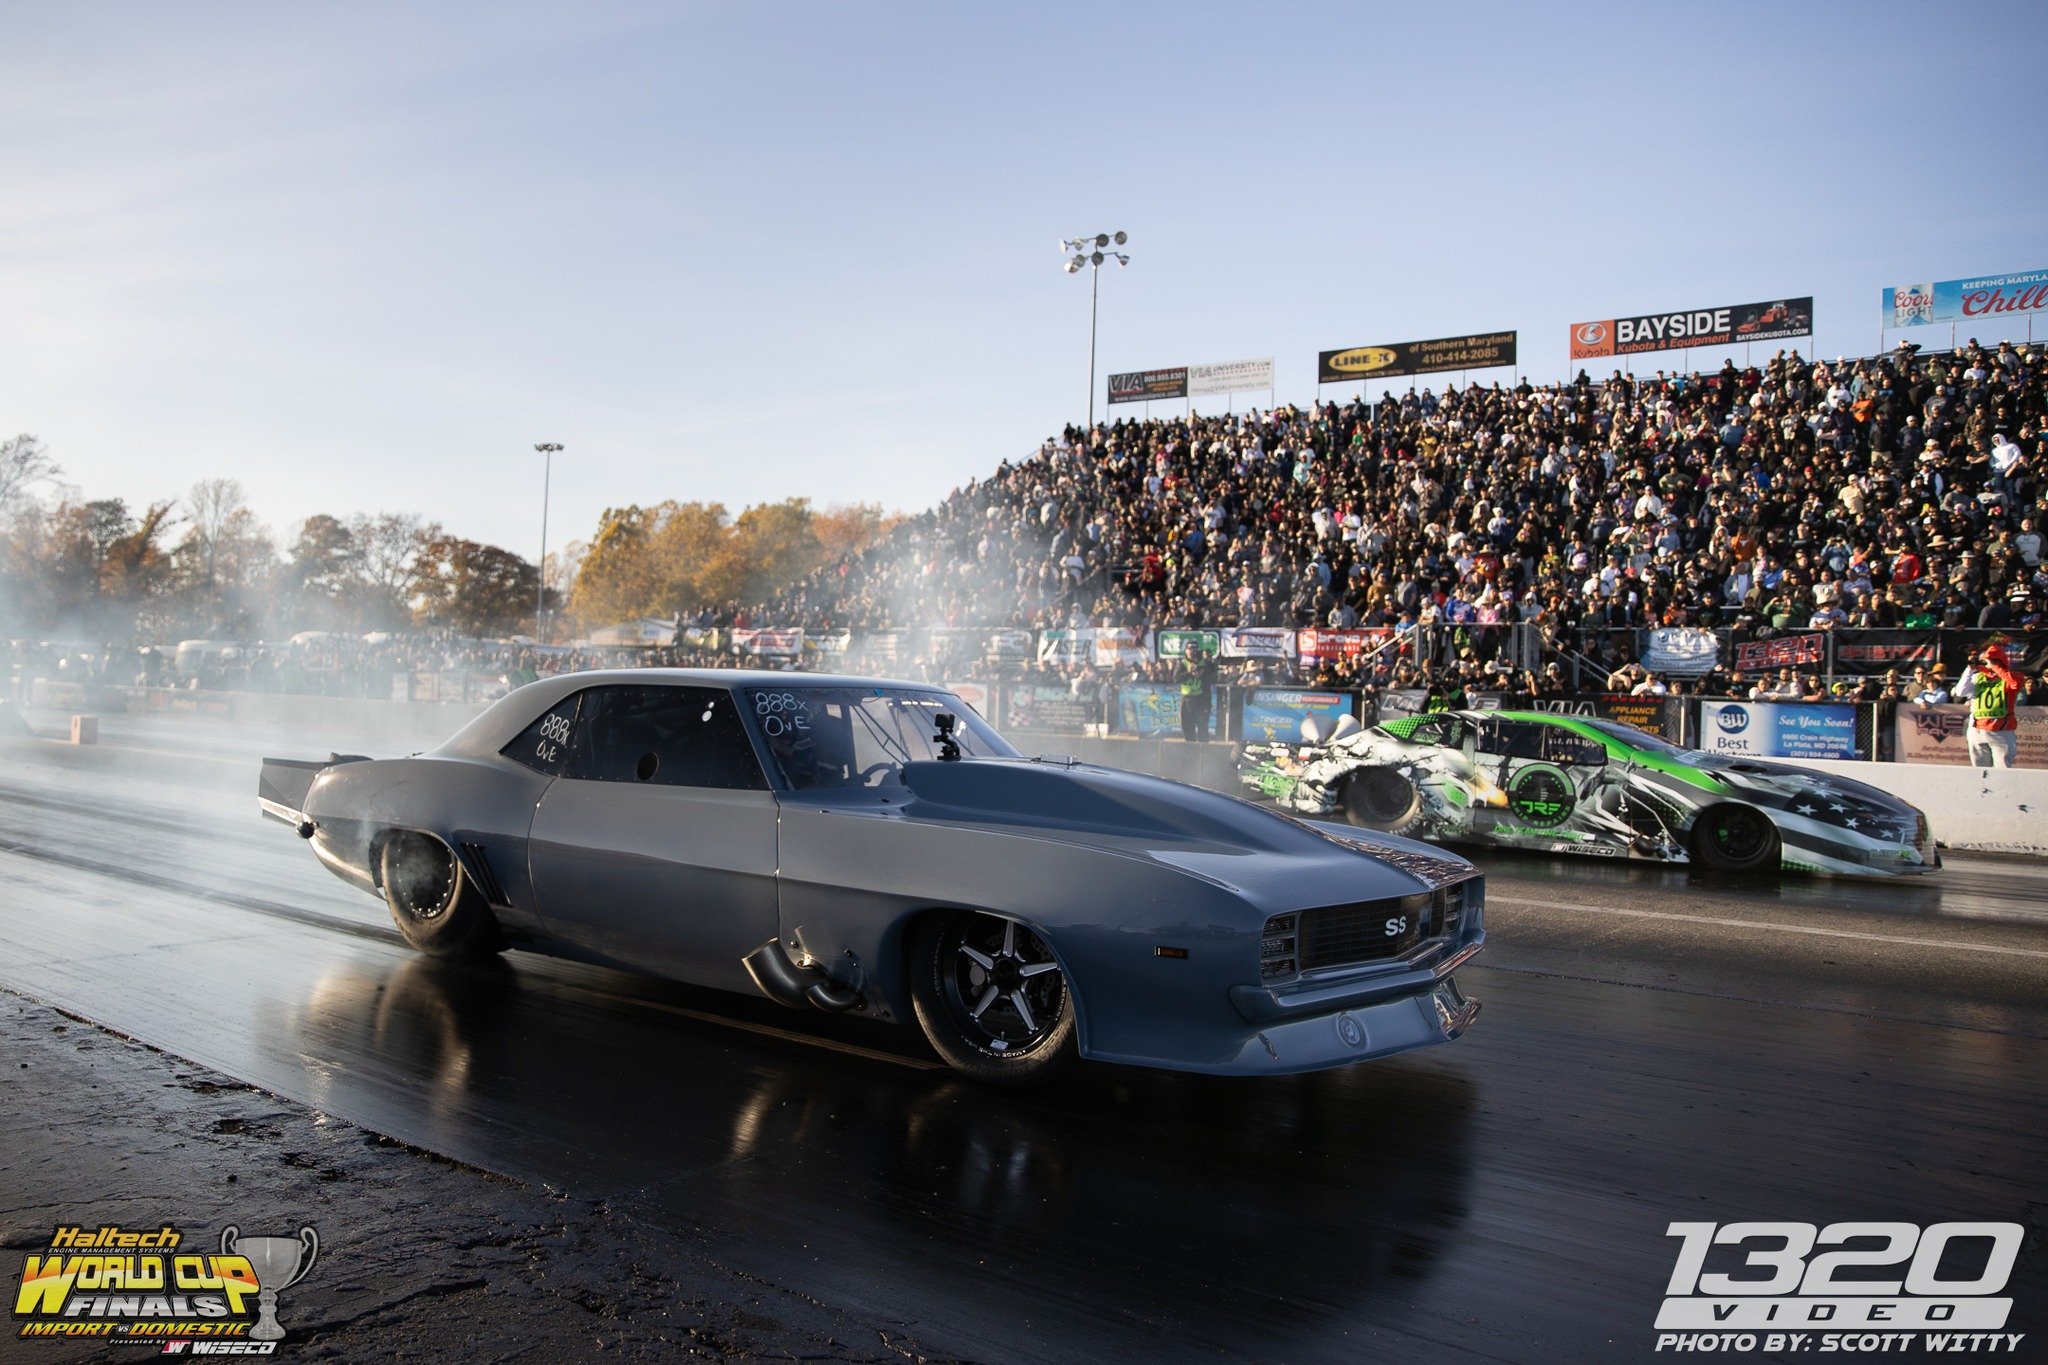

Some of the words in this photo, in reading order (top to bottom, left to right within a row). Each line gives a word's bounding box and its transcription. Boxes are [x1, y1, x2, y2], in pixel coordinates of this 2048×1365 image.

[1963, 279, 2004, 289] KEEPING
[1894, 291, 1934, 309] Coors
[1896, 307, 1932, 318] LIGHT
[1617, 310, 1731, 343] BAYSIDE
[1736, 328, 1809, 341] BAYSIDEKUBOTA.COM
[1409, 344, 1420, 352] of
[1421, 338, 1465, 352] Southern
[1467, 333, 1513, 347] Maryland
[1617, 340, 1656, 353] Kubota
[1658, 340, 1666, 349] &
[1669, 333, 1730, 348] Equipment
[1334, 352, 1391, 367] LINE-X
[1422, 347, 1499, 364] 410-414-2085
[1574, 348, 1610, 358] Kubota
[1109, 374, 1144, 393] VIA
[1976, 690, 2004, 710] 101
[1609, 706, 1657, 715] APPLIANCE
[1616, 715, 1649, 724] REPAIR
[1779, 715, 1797, 725] See
[1799, 716, 1822, 729] You
[1824, 717, 1855, 728] Soon!
[1717, 737, 1749, 749] Best
[1385, 915, 1407, 937] SS
